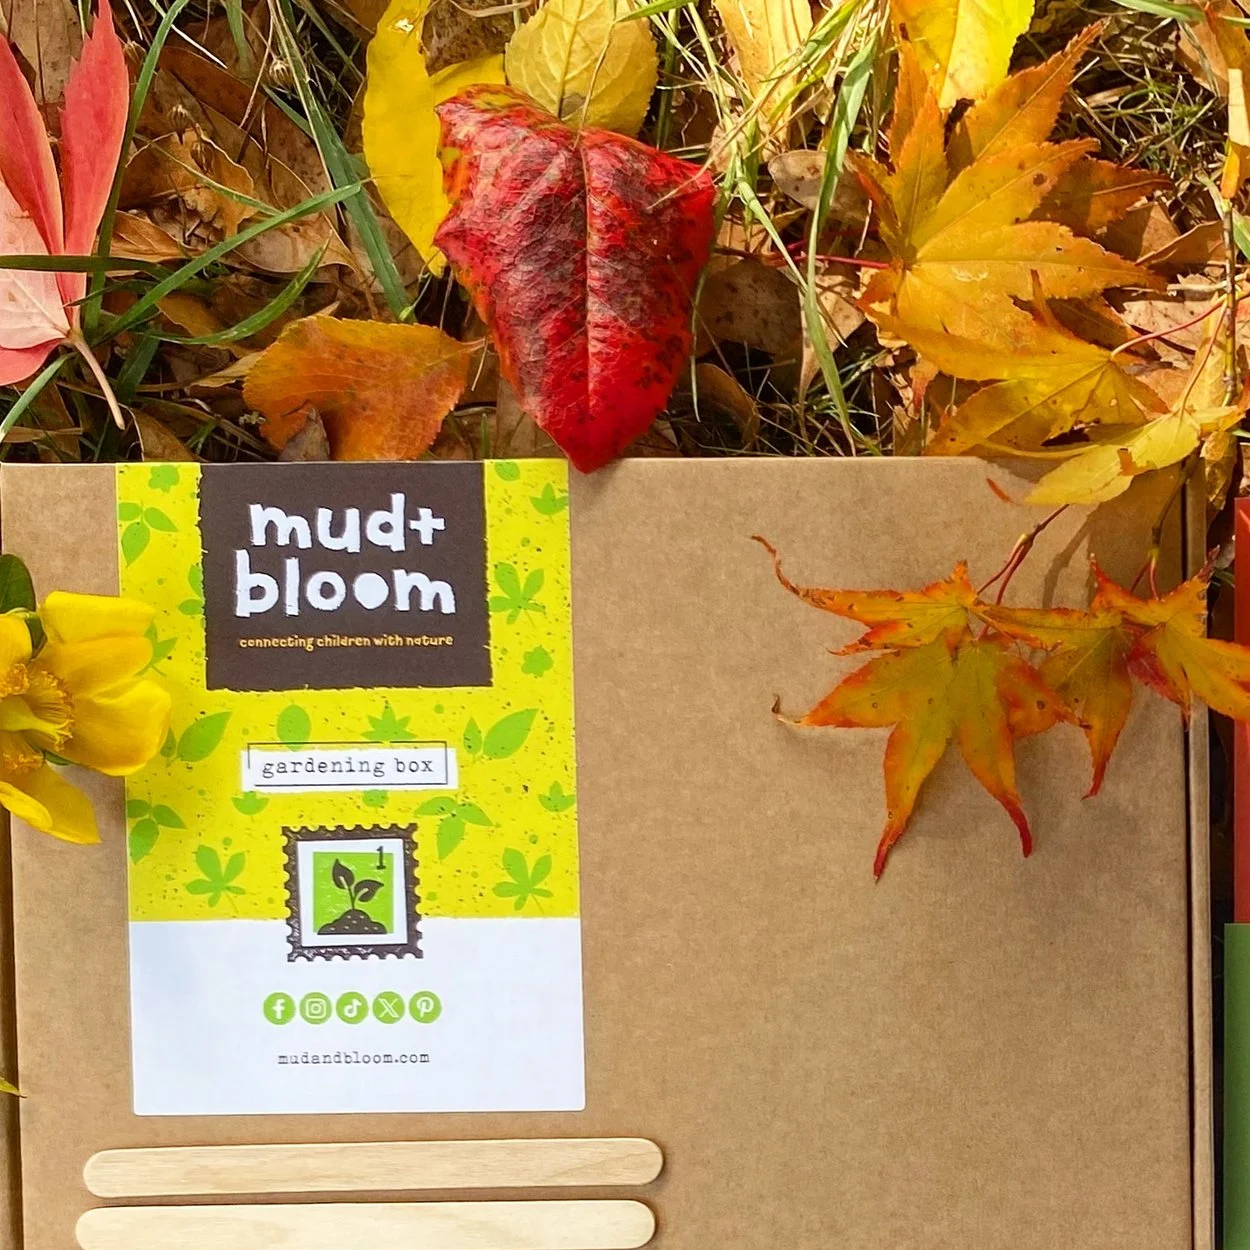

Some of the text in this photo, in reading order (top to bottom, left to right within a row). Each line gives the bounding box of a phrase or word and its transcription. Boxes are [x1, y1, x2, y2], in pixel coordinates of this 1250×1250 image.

[249, 493, 446, 553] mud+
[235, 549, 455, 618] bloom
[239, 633, 454, 652] connecting children with nature
[262, 756, 433, 779] gardening box
[375, 845, 388, 872] 1
[277, 1050, 430, 1065] mudandbloom.com
